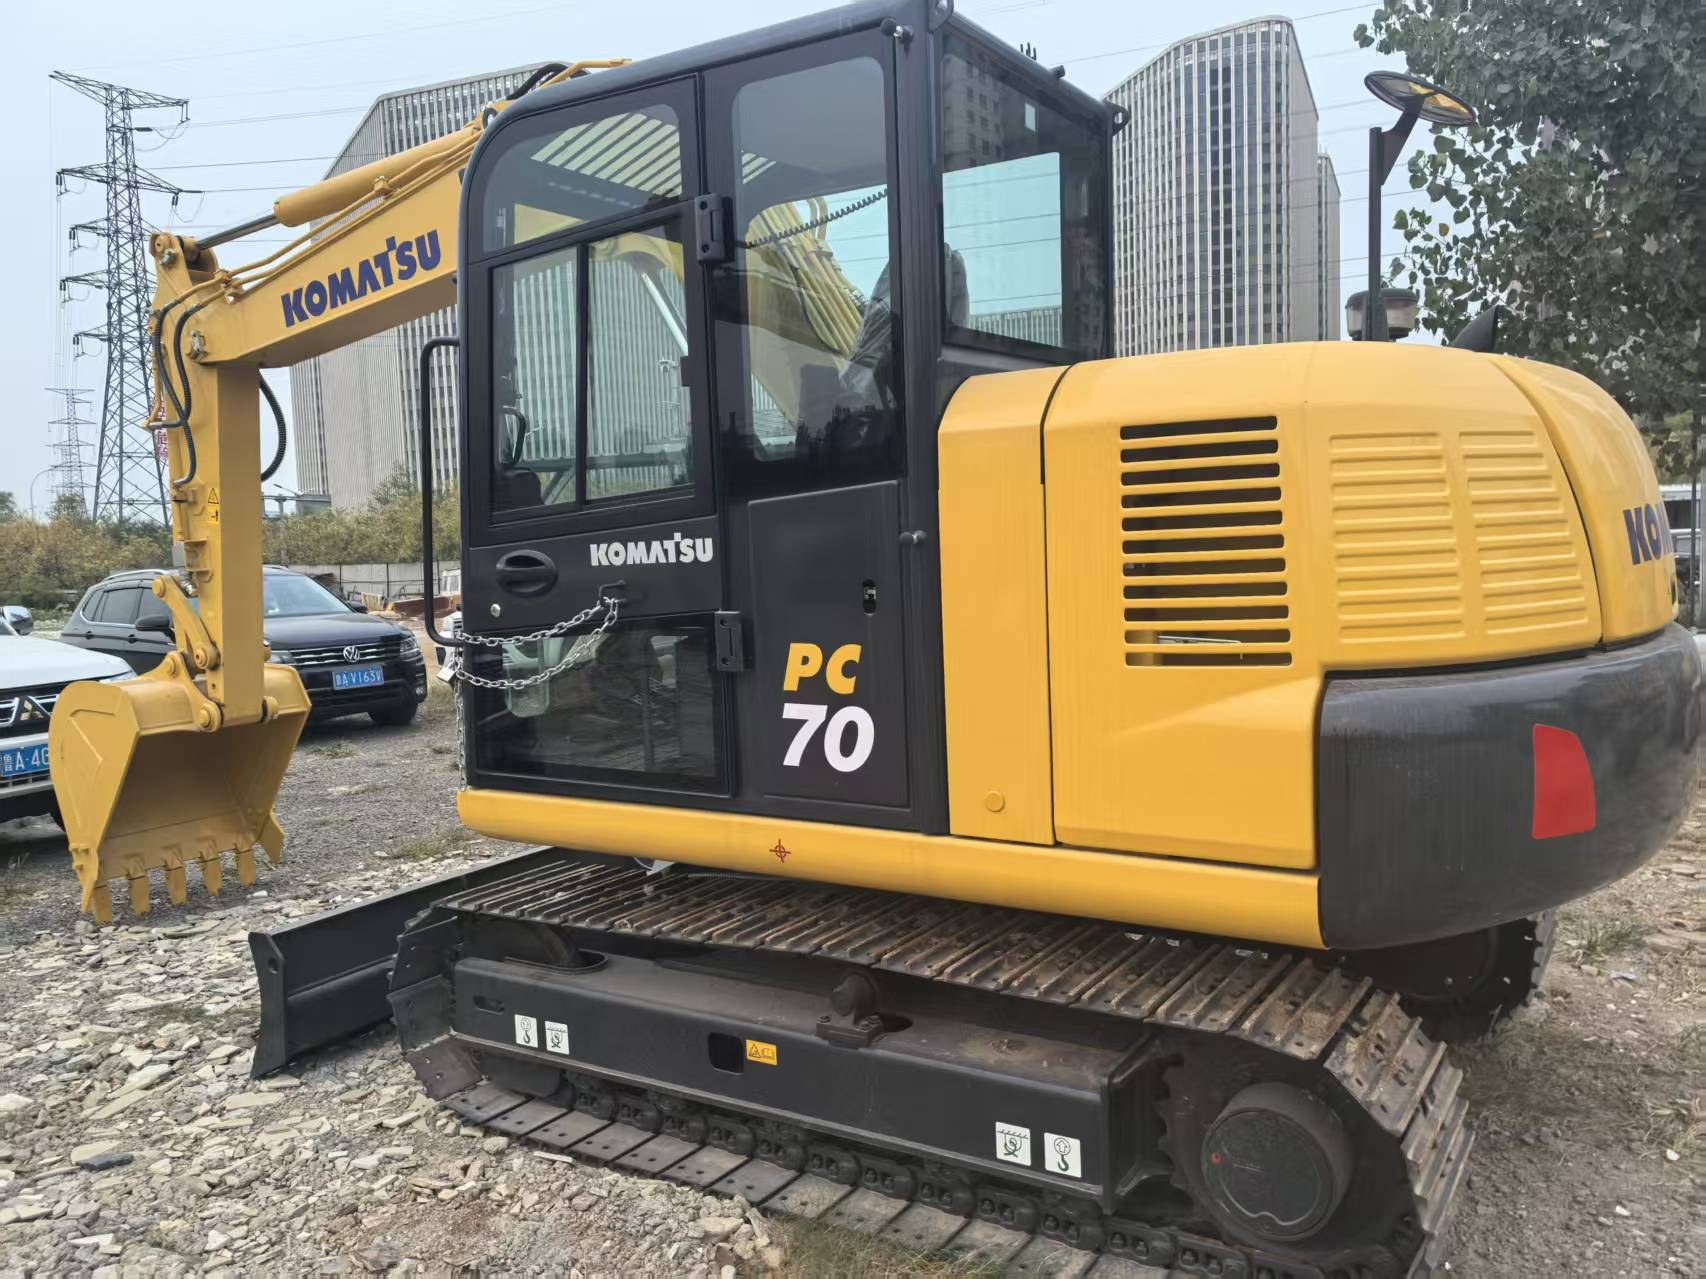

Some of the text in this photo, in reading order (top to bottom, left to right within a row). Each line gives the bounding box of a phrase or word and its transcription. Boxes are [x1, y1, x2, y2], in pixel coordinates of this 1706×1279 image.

[281, 229, 441, 328] KOMATSU
[589, 532, 713, 566] KOMATSU
[783, 642, 862, 695] PC
[782, 702, 875, 773] 70
